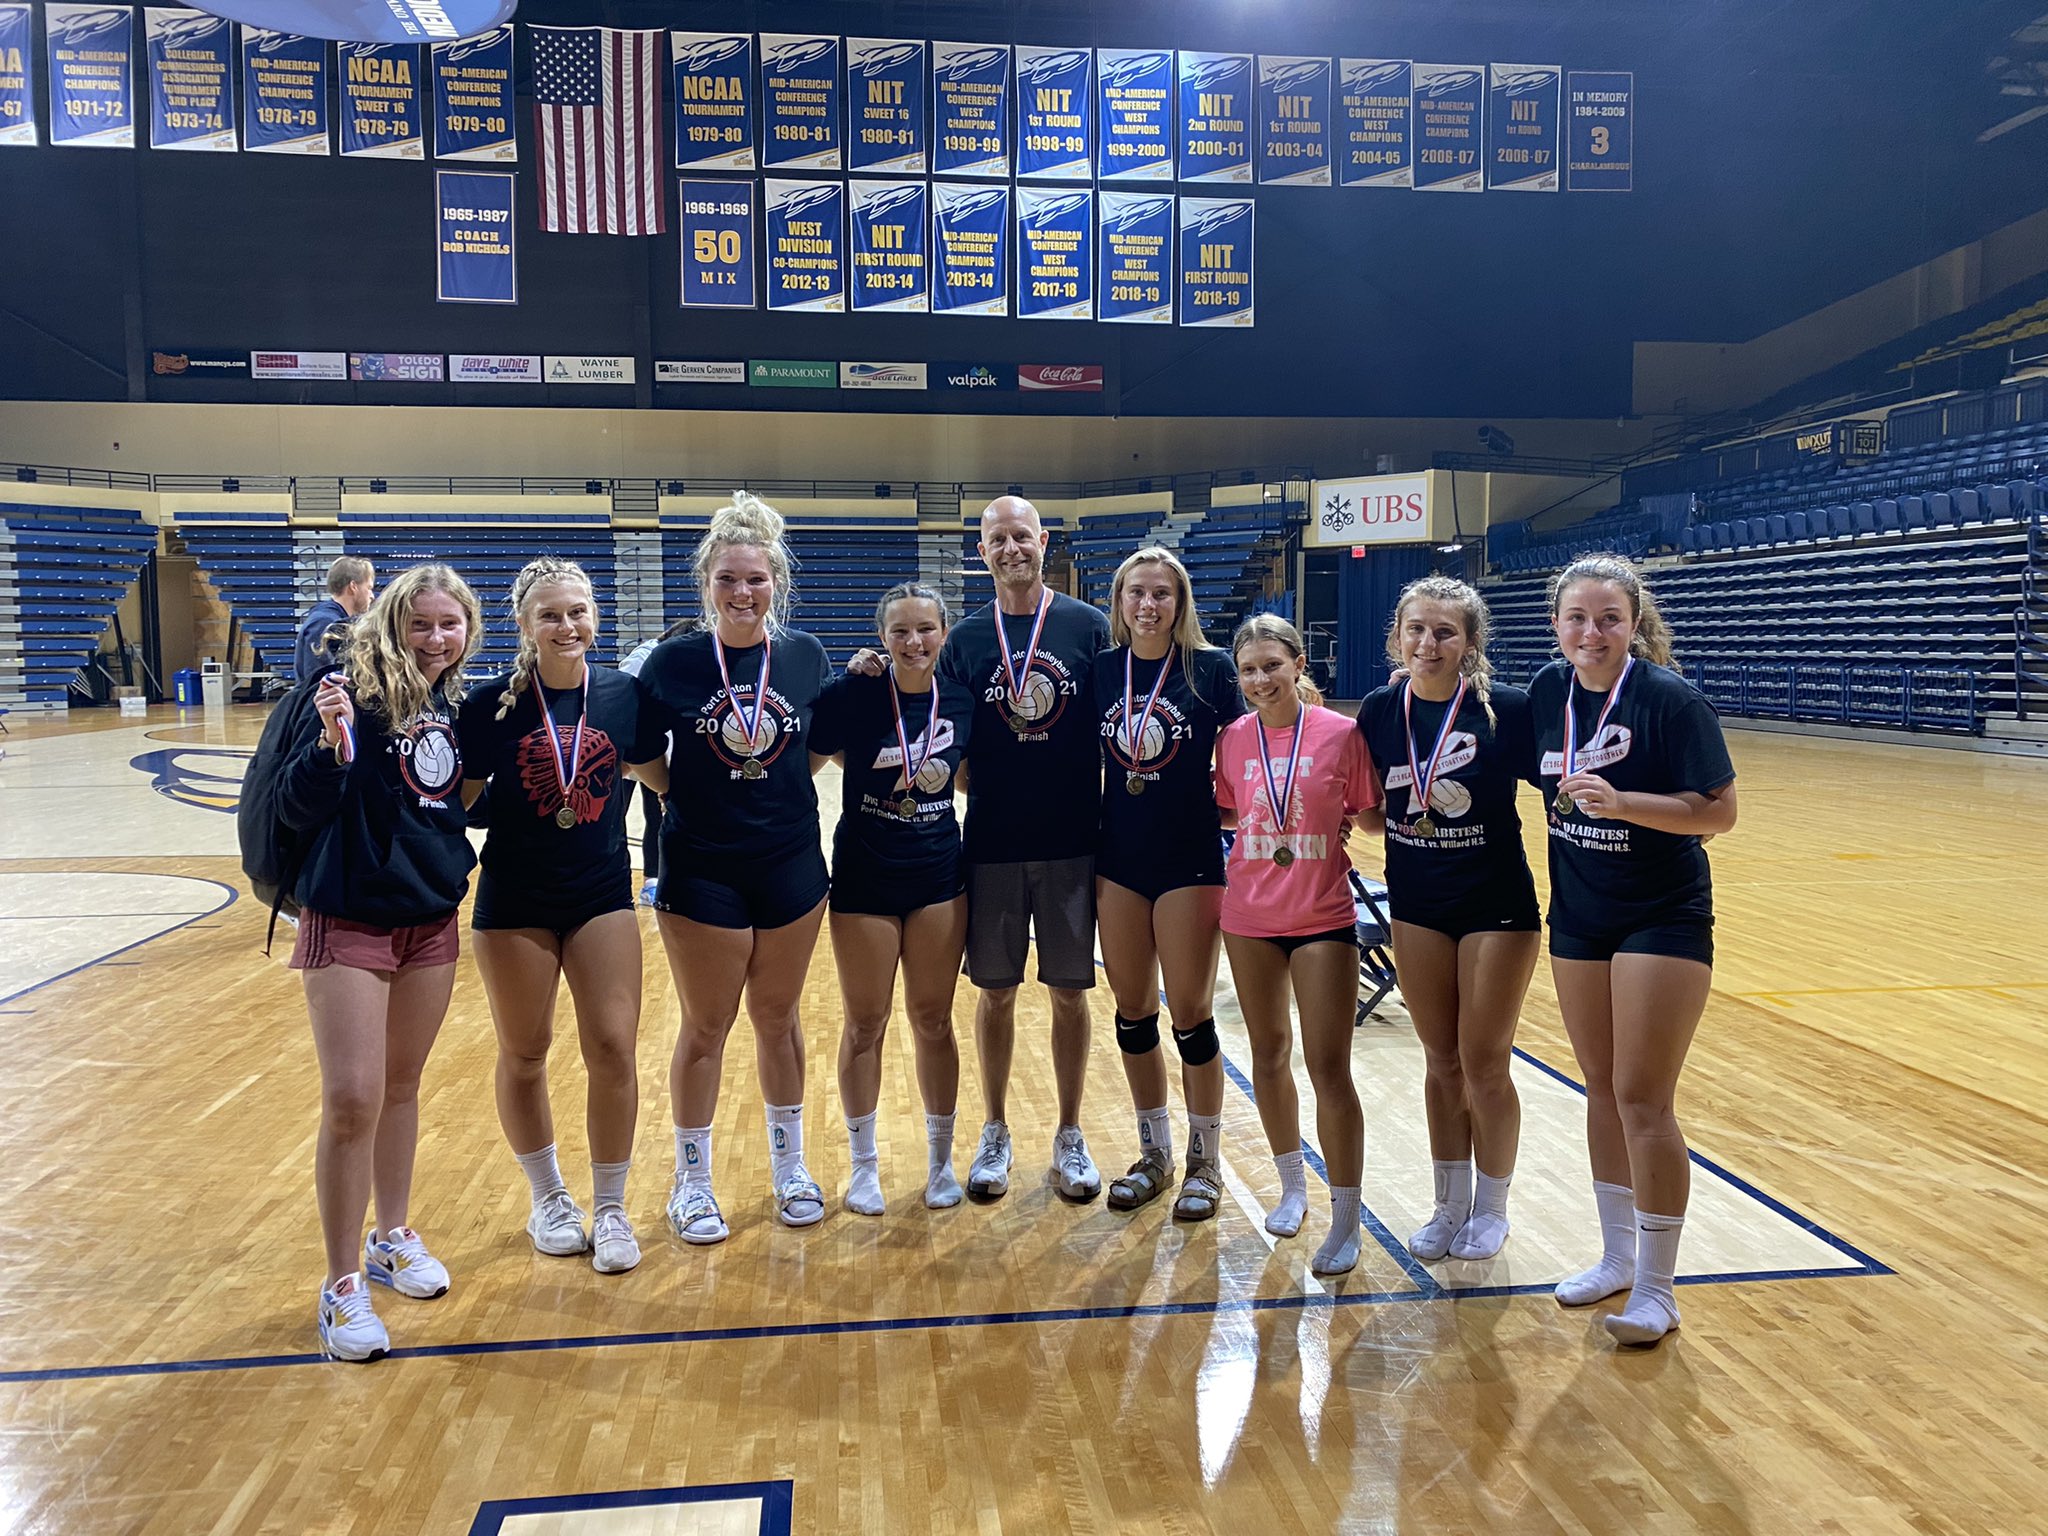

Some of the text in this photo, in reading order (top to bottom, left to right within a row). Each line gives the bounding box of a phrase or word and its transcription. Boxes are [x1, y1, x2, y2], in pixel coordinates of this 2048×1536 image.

[56, 50, 126, 62] MID-AMERICAN
[166, 50, 215, 60] COLLEGIATE
[63, 64, 120, 76] CONFERENCE
[157, 61, 225, 73] COMMISSIONERS
[251, 58, 320, 72] MID-AMERICAN
[348, 57, 411, 85] NCAA
[163, 73, 220, 84] ASSOCIATION
[258, 73, 313, 85] CONFERENCE
[440, 67, 507, 80] MID-AMERICAN
[65, 79, 120, 90] CHAMPIONS
[163, 84, 220, 96] TOURNAMENT
[447, 80, 501, 93] CONFERENCE
[684, 76, 743, 100] NCAA
[769, 77, 832, 90] MID-AMERICAN
[941, 81, 1002, 94] MID-AMERICAN
[259, 86, 313, 100] CHAMPIONS
[347, 84, 413, 99] TOURNAMENT
[775, 91, 827, 103] CONFERENCE
[868, 80, 904, 104] NIT
[1105, 88, 1166, 100] MID-AMERICAN
[1573, 92, 1628, 102] IN MEMORY
[169, 96, 217, 107] 3RD PLACE
[448, 95, 501, 108] CHAMPIONS
[946, 94, 997, 106] CONFERENCE
[1036, 89, 1072, 112] NIT
[1111, 100, 1160, 111] CONFERENCE
[1199, 93, 1233, 117] NIT
[1343, 96, 1409, 107] MID-AMERICAN
[1421, 101, 1474, 111] MID-AMERICAN
[65, 100, 123, 117] 1971-72
[356, 100, 405, 114] SWEET 16
[683, 104, 745, 116] TOURNAMENT
[777, 104, 827, 117] CHAMPIONS
[960, 107, 983, 118] WEST
[1278, 96, 1312, 118] NIT
[1348, 108, 1404, 119] CONFERENCE
[1511, 101, 1539, 121] NIT
[164, 113, 223, 128] 1973-74
[257, 108, 316, 126] 1978-79
[864, 108, 909, 120] SWEET 16
[1124, 113, 1147, 123] WEST
[1425, 114, 1469, 124] CONFERENCE
[354, 119, 409, 136] 1978-79
[446, 116, 505, 133] 1979-80
[947, 118, 996, 131] CHAMPIONS
[1047, 115, 1081, 128] ROUND
[1210, 120, 1243, 133] ROUND
[1288, 121, 1320, 134] ROUND
[1364, 120, 1389, 131] WEST
[687, 126, 742, 142] 1979-80
[774, 125, 830, 142] 1980-81
[860, 128, 914, 144] 1980-81
[1112, 124, 1160, 135] CHAMPIONS
[1426, 127, 1469, 138] CHAMPIONS
[943, 136, 1000, 152] 1998-99
[1025, 136, 1084, 152] 1998-99
[1350, 132, 1402, 143] CHAMPIONS
[1591, 126, 1609, 155] 3
[1107, 143, 1165, 156] 1999-2000
[1188, 141, 1243, 156] 2000-01
[1267, 142, 1322, 157] 2003-04
[1352, 151, 1400, 164] 2004-05
[1421, 149, 1474, 164] 2006-07
[1498, 148, 1550, 164] 2006-07
[443, 208, 508, 222] 1965-1987
[685, 202, 748, 215] 1966-1969
[788, 221, 822, 236] WEST
[1027, 230, 1082, 240] MID-AMERICAN
[455, 230, 498, 241] COACH
[872, 225, 904, 248] NIT
[943, 231, 998, 242] MID-AMERICAN
[1109, 234, 1163, 245] MID-AMERICAN
[443, 242, 510, 254] BOB NICHOLS
[694, 230, 741, 263] 50
[779, 238, 832, 254] DIVISION
[948, 242, 993, 253] CONFERENCE
[1032, 241, 1077, 250] CONFERENCE
[1114, 246, 1159, 256] CONFERENCE
[855, 253, 923, 267] FIRST ROUND
[946, 255, 995, 267] CHAMPIONS
[1043, 255, 1066, 265] WEST
[1200, 244, 1233, 268] NIT
[773, 258, 838, 270] CO-CHAMPIONS
[1124, 259, 1147, 269] WEST
[701, 272, 736, 284] MIX
[1031, 266, 1078, 277] CHAMPIONS
[1112, 270, 1160, 281] CHAMPIONS
[1185, 272, 1248, 284] FIRST ROUND
[782, 275, 830, 290] 2012-13
[866, 273, 914, 288] 2013-14
[947, 272, 993, 287] 2013-14
[1032, 282, 1077, 297] 2017-18
[1112, 286, 1160, 302] 2018-19
[1194, 291, 1240, 306] 2018-19
[398, 357, 440, 365] TOLEDO
[463, 358, 529, 368] dave white
[581, 359, 619, 367] WAYNE
[771, 368, 830, 378] PARAMOUNT
[948, 374, 997, 388] valpak
[1858, 439, 1874, 447] 101
[1360, 493, 1422, 524] UBS
[989, 665, 1004, 683] Port
[1035, 649, 1071, 677] Volleyball
[985, 680, 1077, 702] 20 21
[701, 696, 720, 715] Port
[1105, 703, 1120, 719] Port
[1156, 697, 1185, 722] olleyball
[695, 717, 800, 733] 20 21
[1100, 722, 1192, 740] 20 21
[1018, 731, 1048, 742] #Finish
[1563, 822, 1629, 840] DIABETES!
[1440, 839, 1469, 848] Willard
[1582, 839, 1631, 851] Willard H.S.
